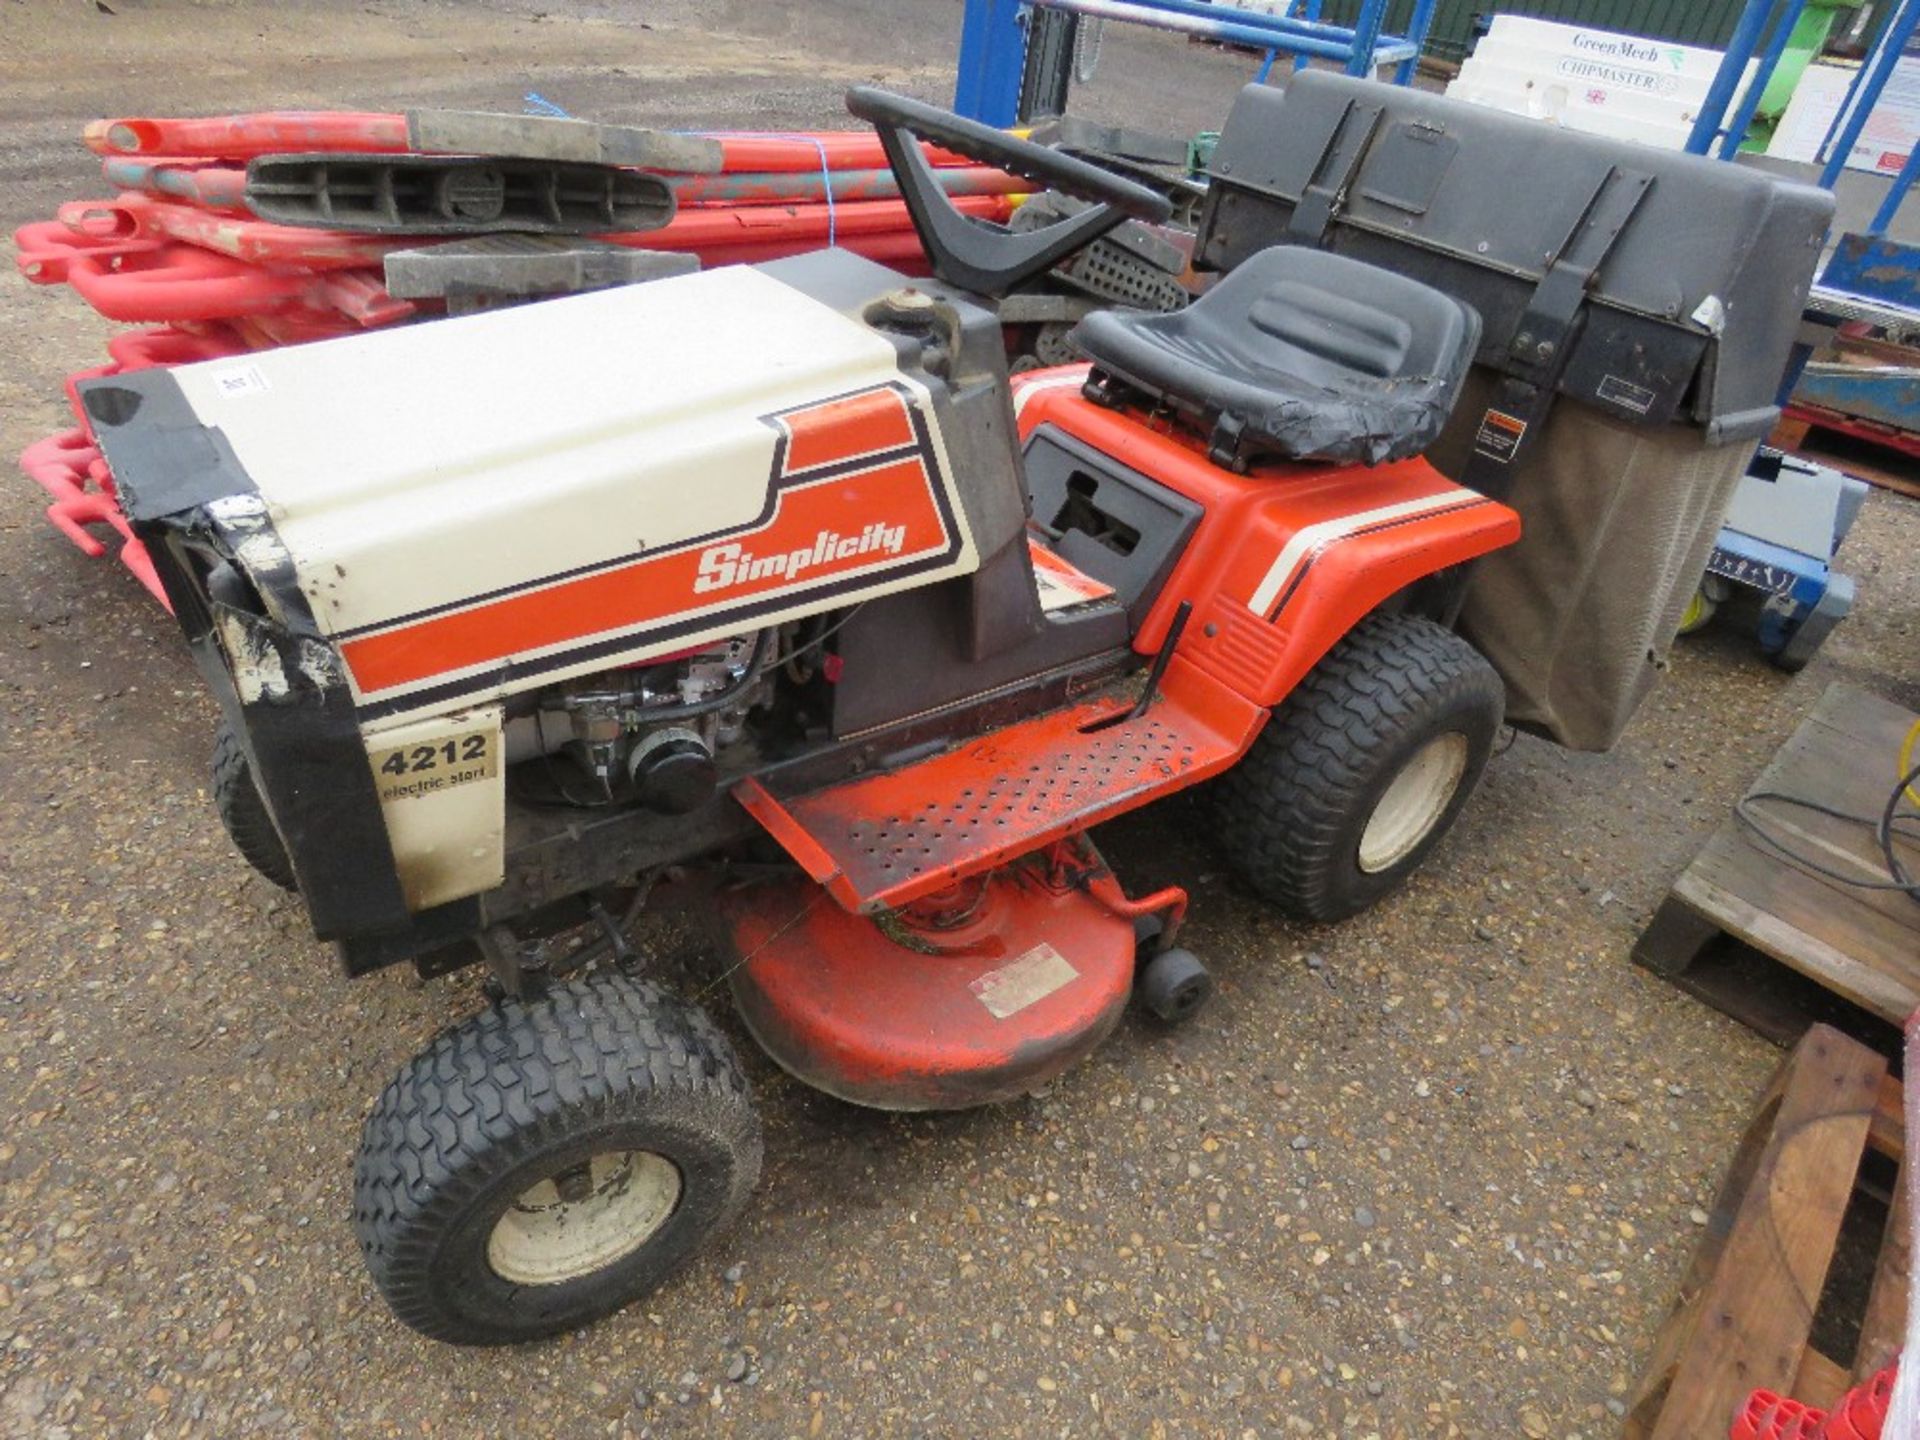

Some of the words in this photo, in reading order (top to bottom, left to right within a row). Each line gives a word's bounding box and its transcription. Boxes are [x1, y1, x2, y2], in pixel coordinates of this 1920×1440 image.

[1572, 32, 1658, 62] GreenMech
[1562, 59, 1654, 88] CHIPMASTER
[693, 522, 906, 595] Simplicity
[381, 734, 486, 776] 4212
[383, 776, 445, 800] electric
[450, 766, 486, 785] start
